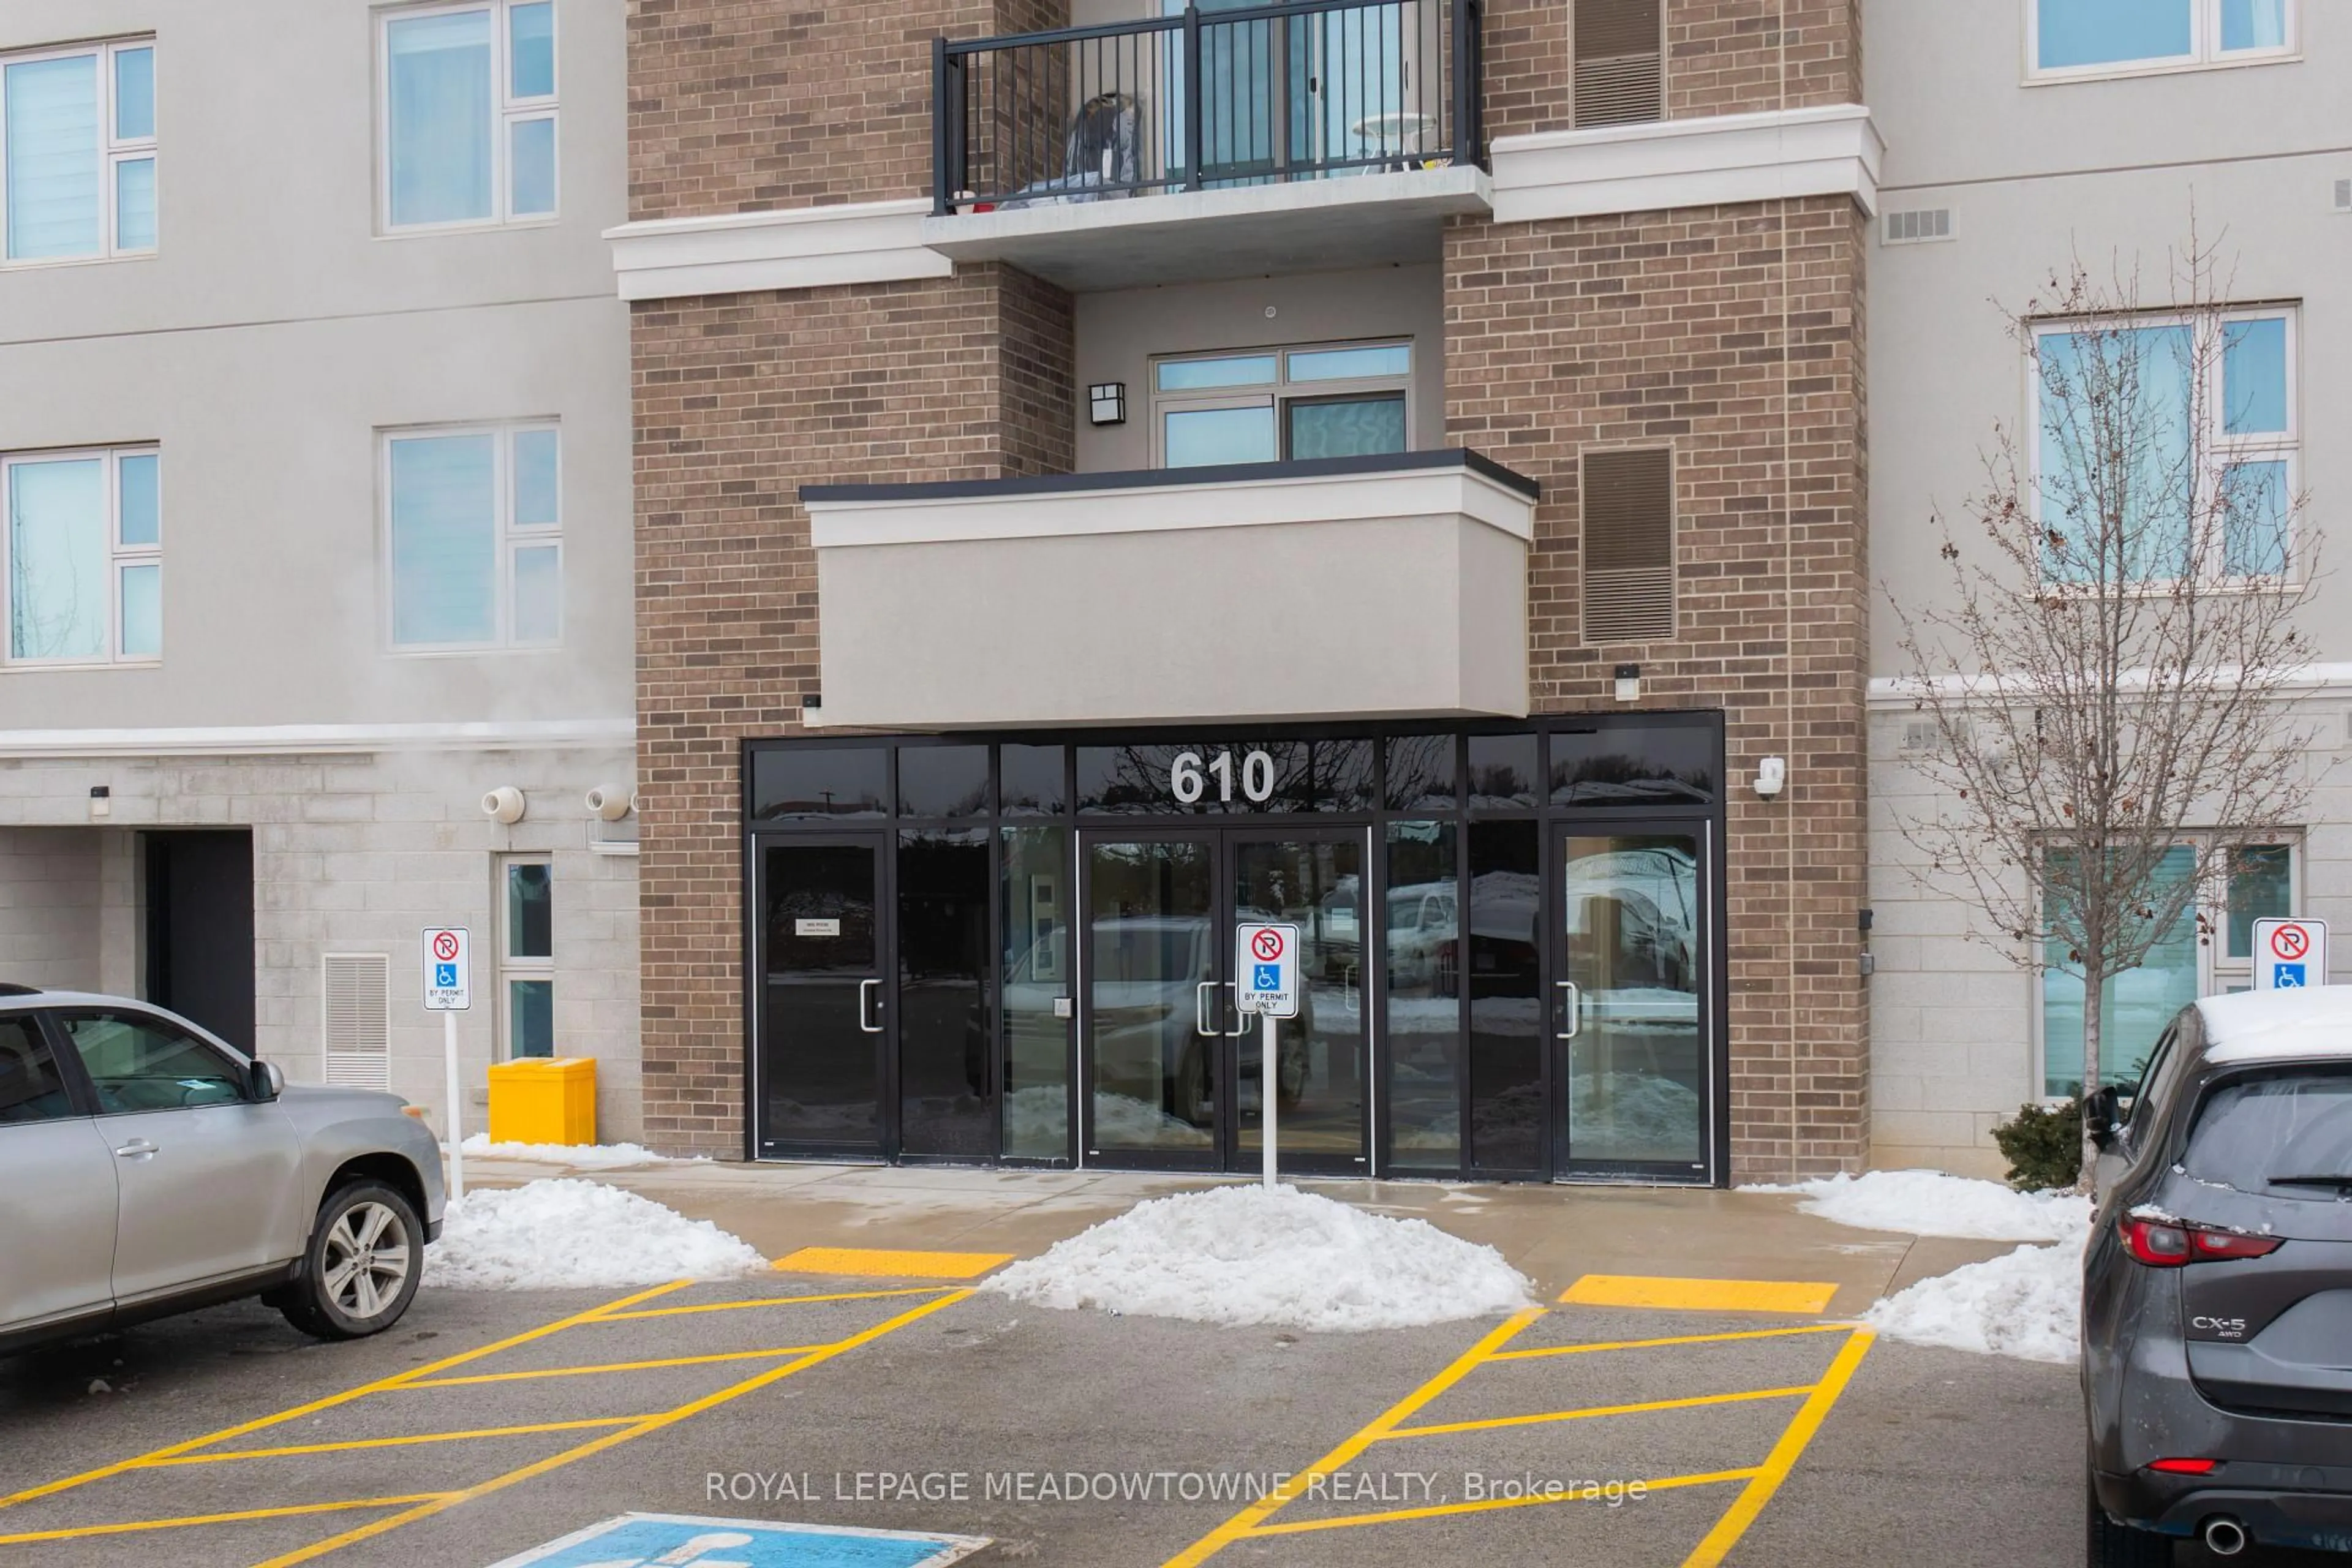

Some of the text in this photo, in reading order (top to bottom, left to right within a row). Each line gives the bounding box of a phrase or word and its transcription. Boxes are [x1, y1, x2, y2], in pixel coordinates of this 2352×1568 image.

[1171, 750, 1274, 803] 610
[1256, 1001, 1277, 1009] ONLY
[2192, 1316, 2246, 1330] CX-5
